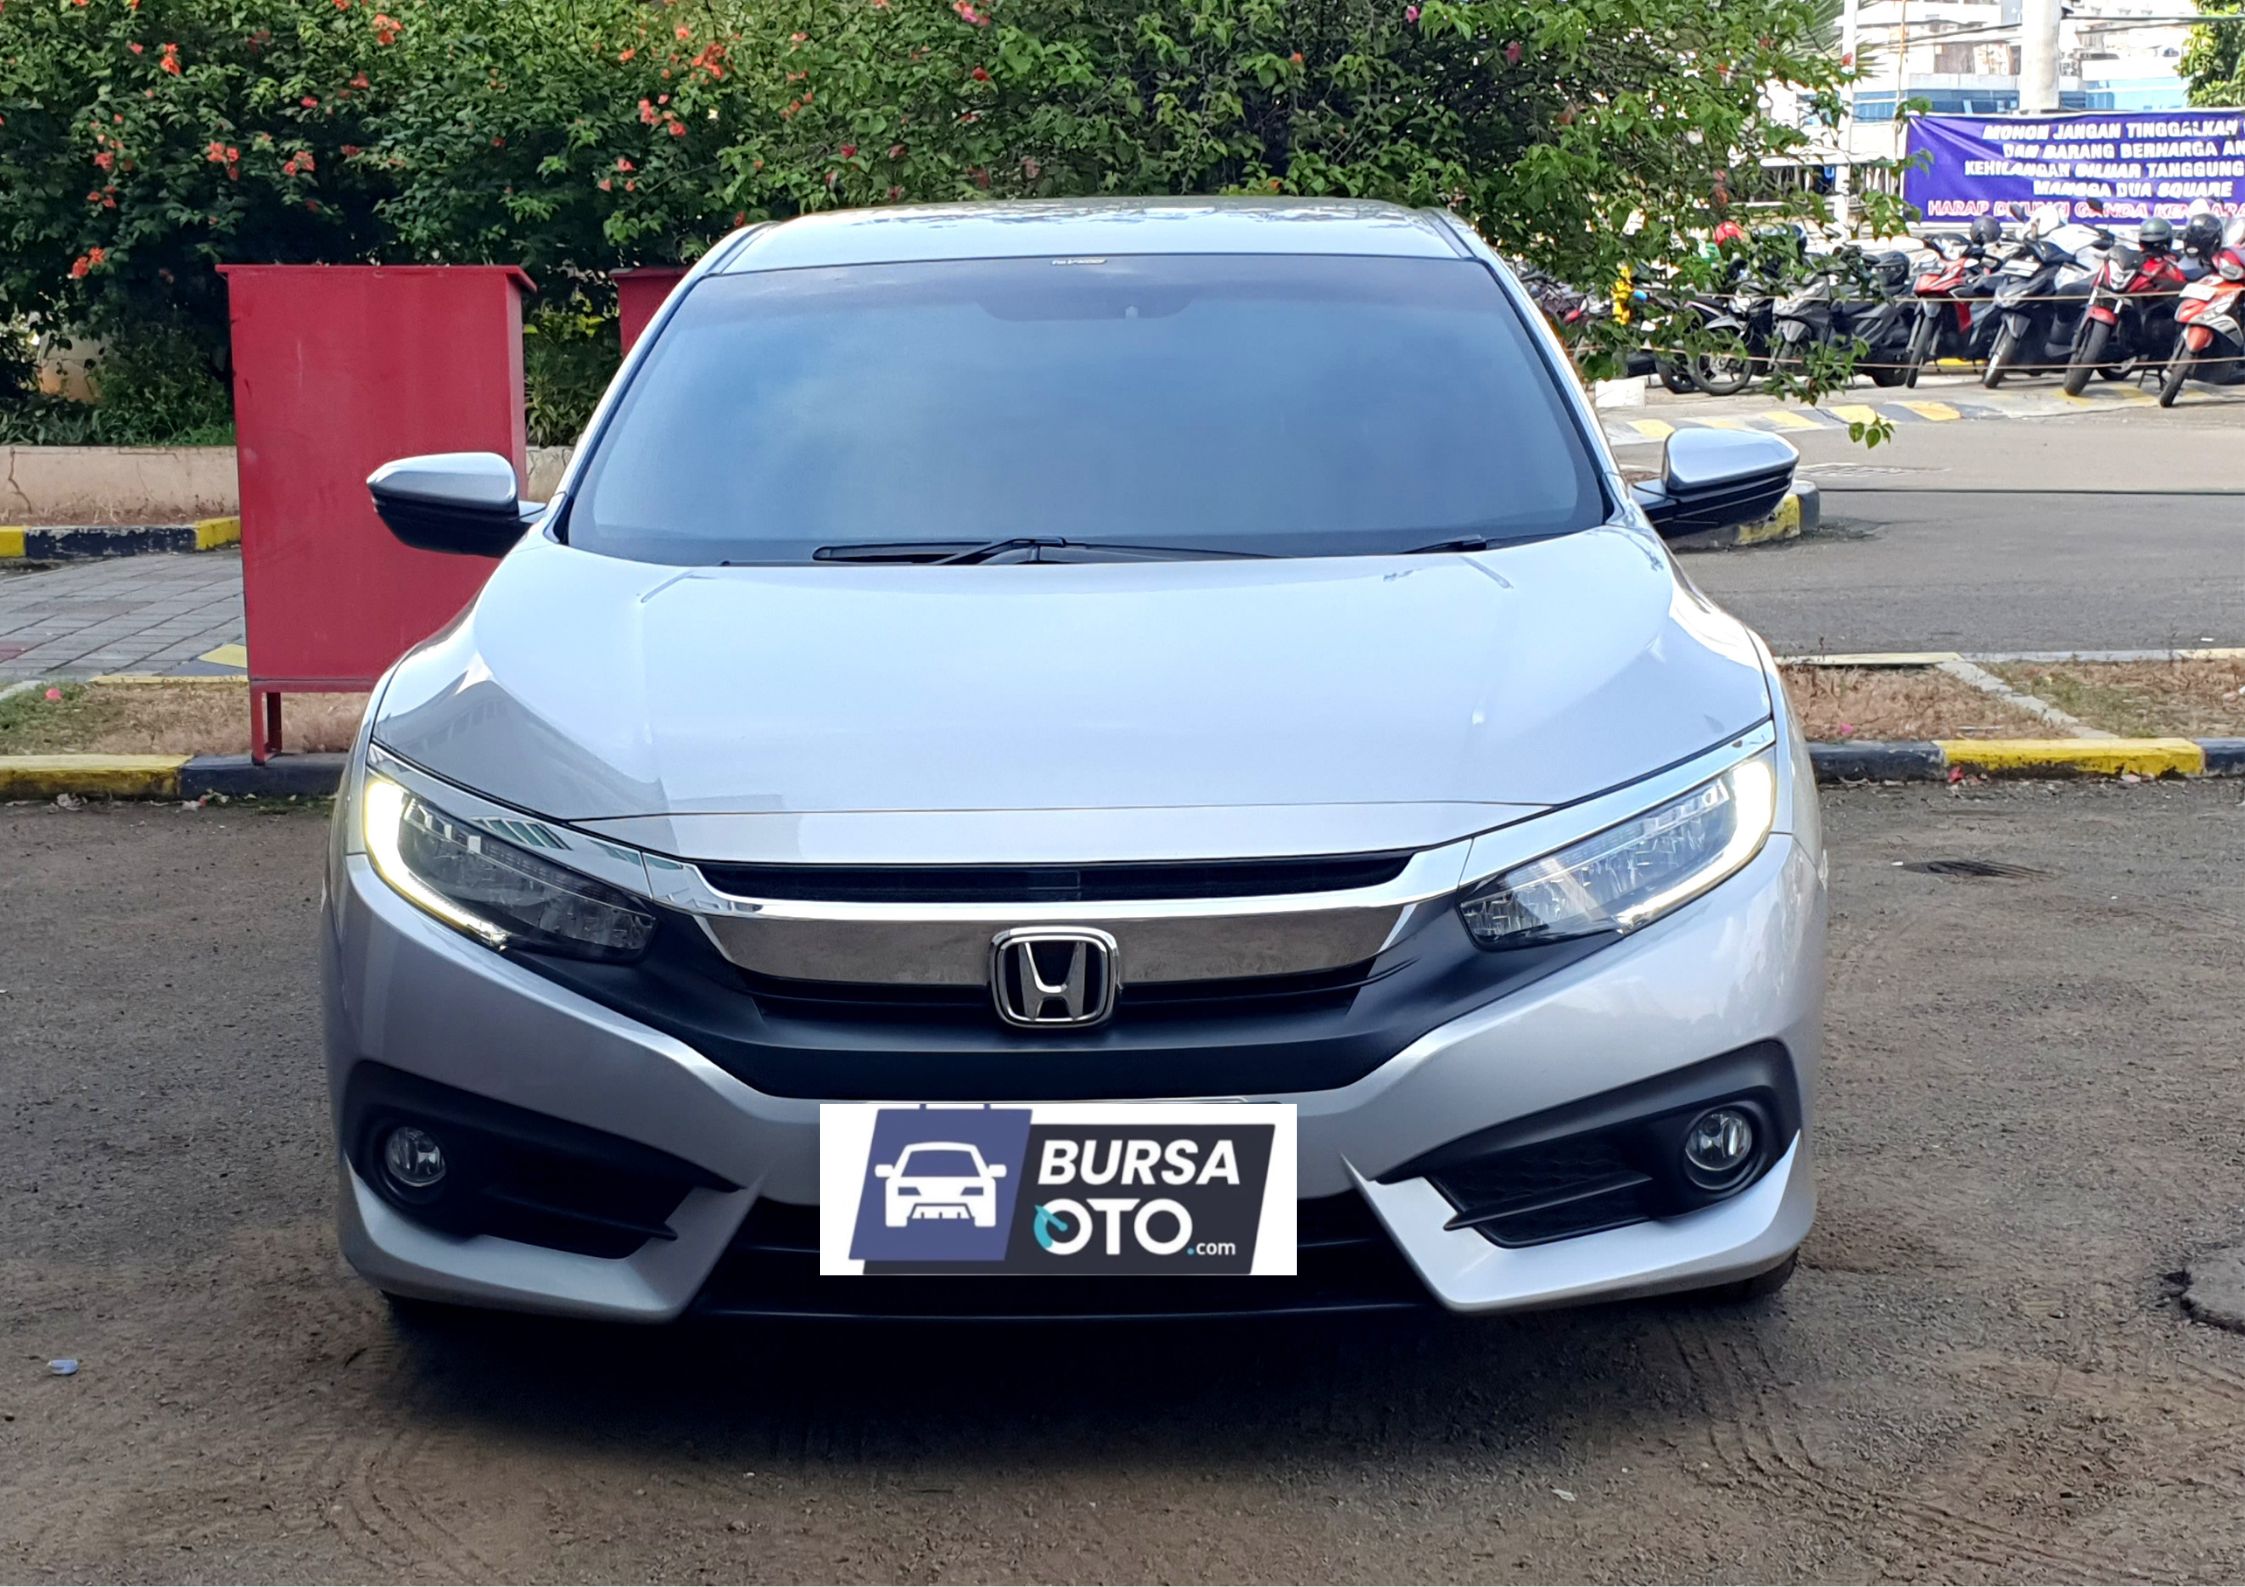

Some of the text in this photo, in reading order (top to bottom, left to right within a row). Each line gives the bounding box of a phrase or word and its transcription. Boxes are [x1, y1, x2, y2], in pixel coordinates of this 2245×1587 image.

[1982, 119, 2239, 140] MOHON JANGAN TINGGALKAN
[2002, 143, 2040, 159] DAN
[2042, 142, 2115, 159] BARANG
[2120, 141, 2219, 159] BERHARGA
[1964, 160, 2071, 177] KEHILANGAN
[2146, 161, 2244, 178] TANGGUNG
[2033, 180, 2233, 198] MANGGA DUA SQUARE
[1927, 200, 1990, 216] HARAP
